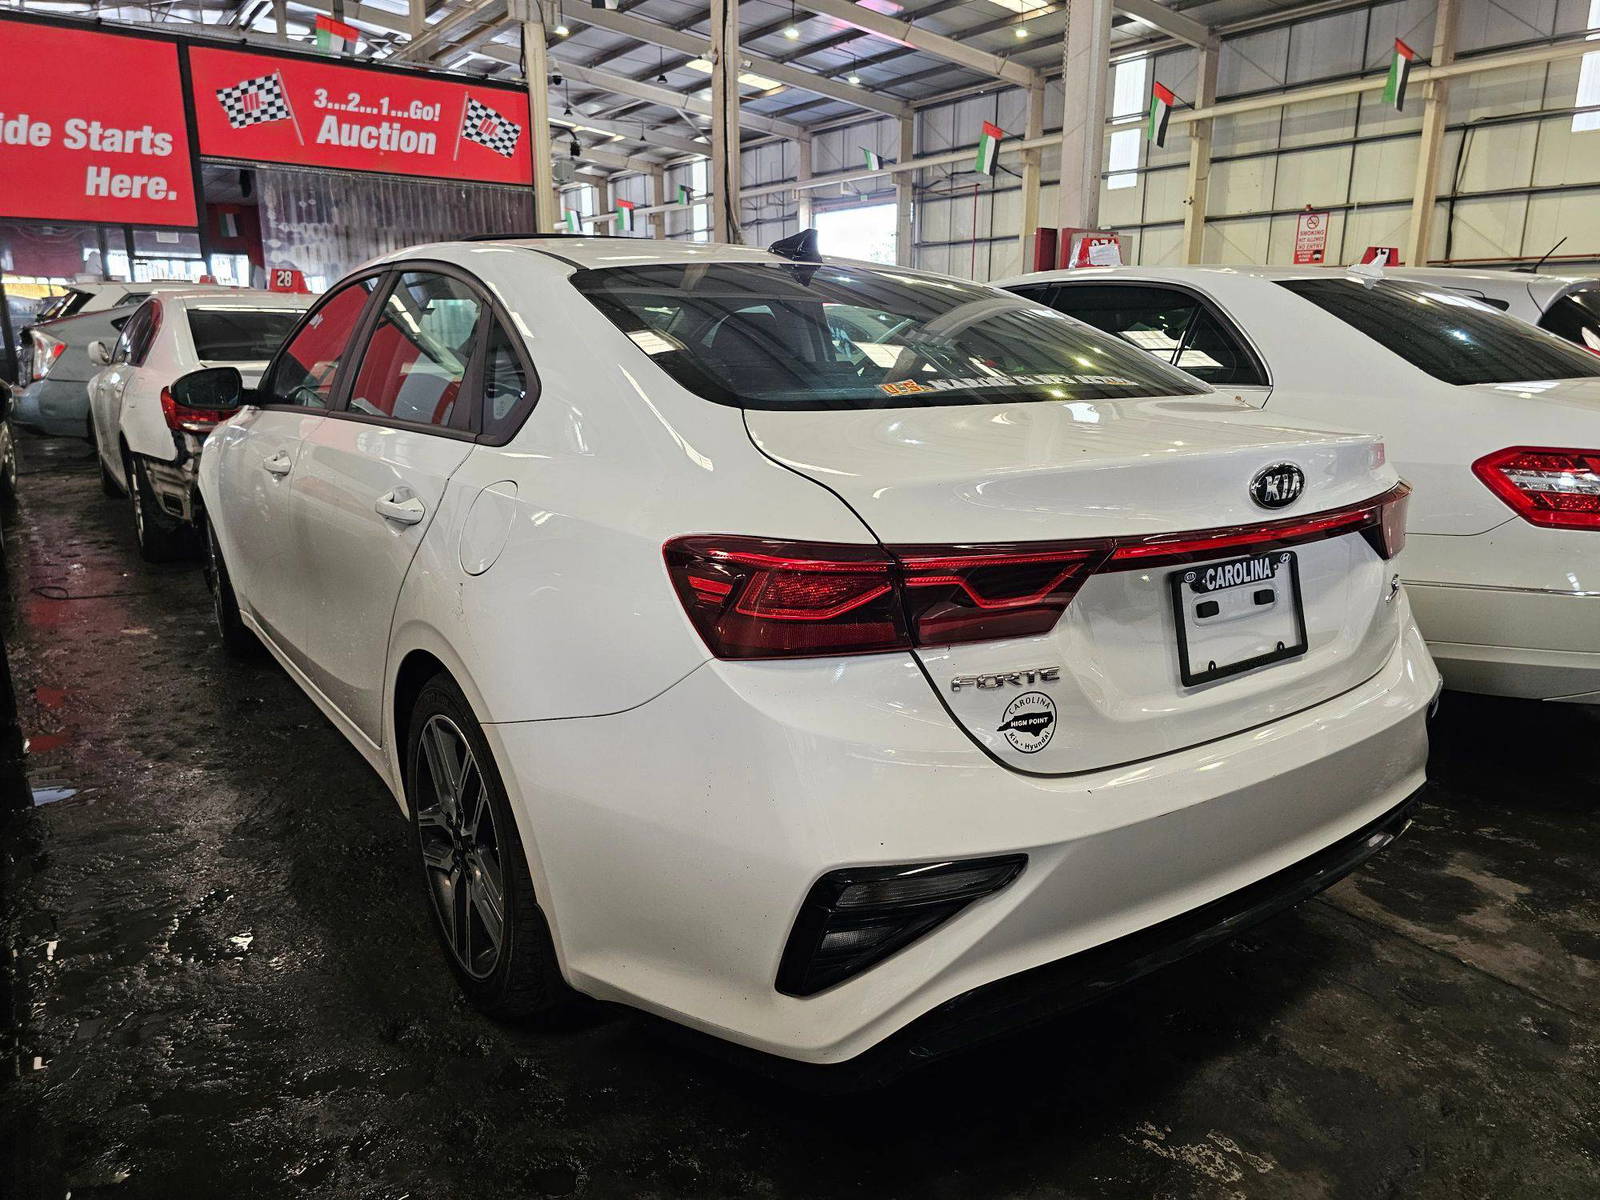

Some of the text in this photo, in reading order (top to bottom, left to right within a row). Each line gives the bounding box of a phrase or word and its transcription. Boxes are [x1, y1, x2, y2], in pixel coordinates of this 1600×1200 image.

[63, 118, 173, 157] Starts
[316, 114, 437, 155] Auction
[85, 165, 177, 200] Here.
[277, 270, 292, 287] 28
[1264, 472, 1301, 501] KIA
[1206, 558, 1271, 590] CAROLINA
[951, 666, 1060, 692] FORTE
[1009, 697, 1051, 714] CAROLINA
[1029, 716, 1049, 725] POINT
[1009, 730, 1051, 751] Kia Hyundai
